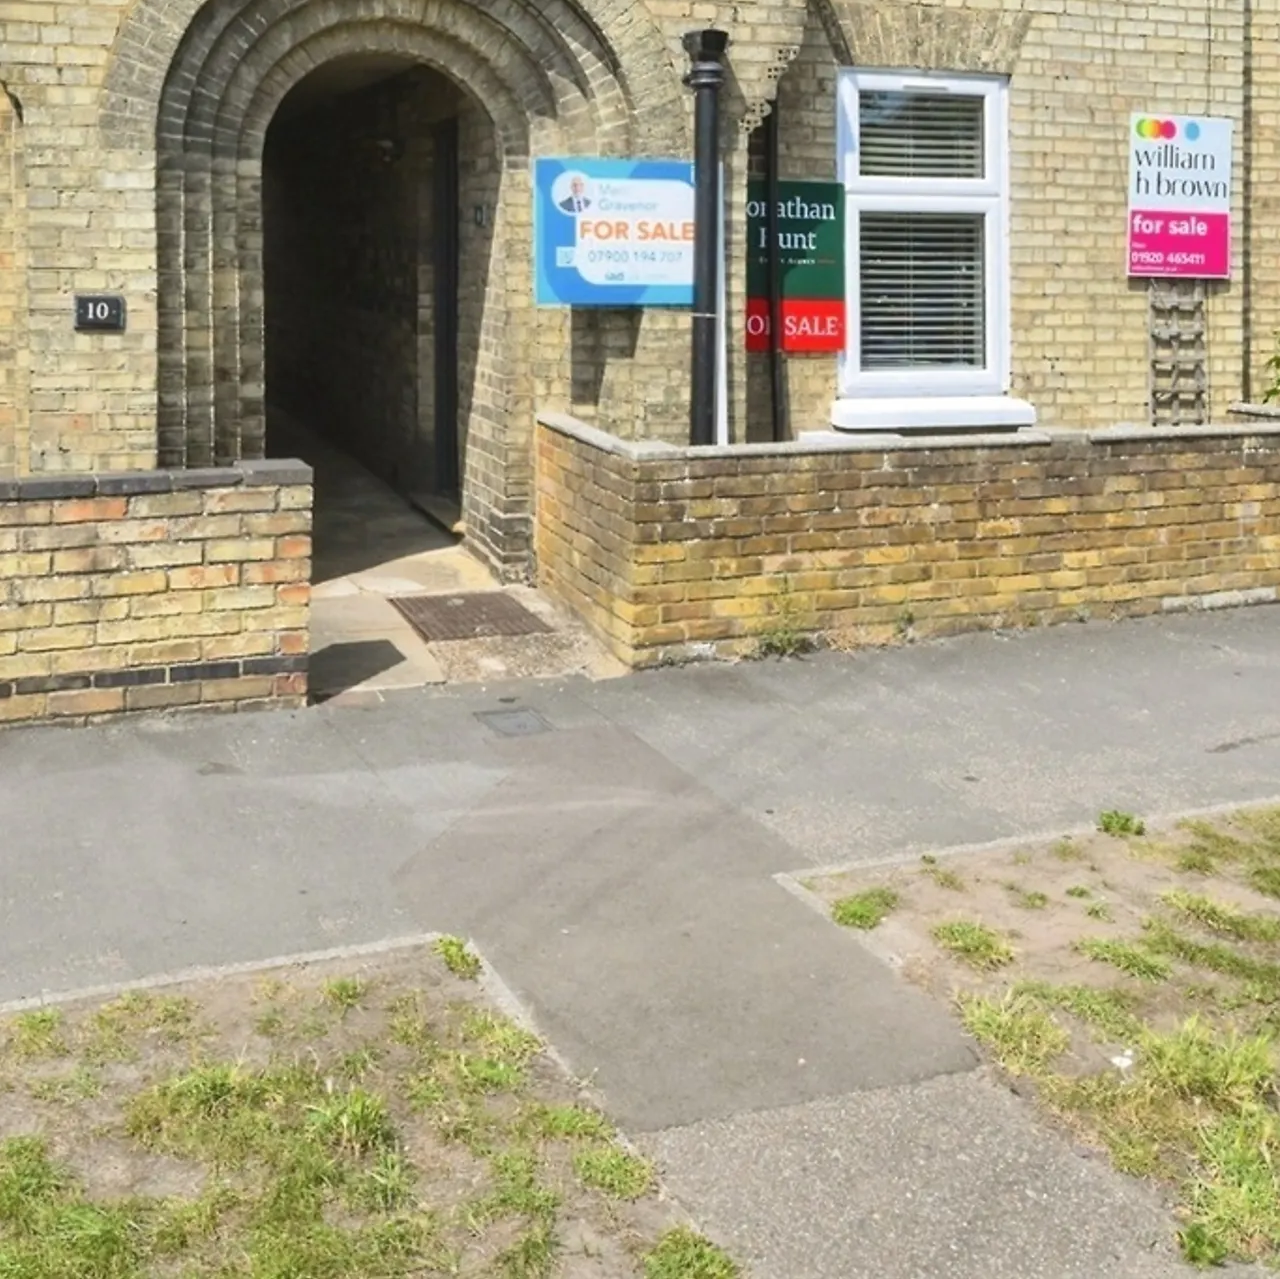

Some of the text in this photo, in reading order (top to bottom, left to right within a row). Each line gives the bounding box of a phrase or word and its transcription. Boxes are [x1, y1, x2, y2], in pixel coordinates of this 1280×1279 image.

[1134, 144, 1215, 171] william
[1136, 170, 1227, 199] h brown
[580, 220, 695, 241] FOR SALE
[1133, 214, 1208, 236] for sale
[87, 302, 110, 320] 10
[784, 315, 839, 336] SALE
